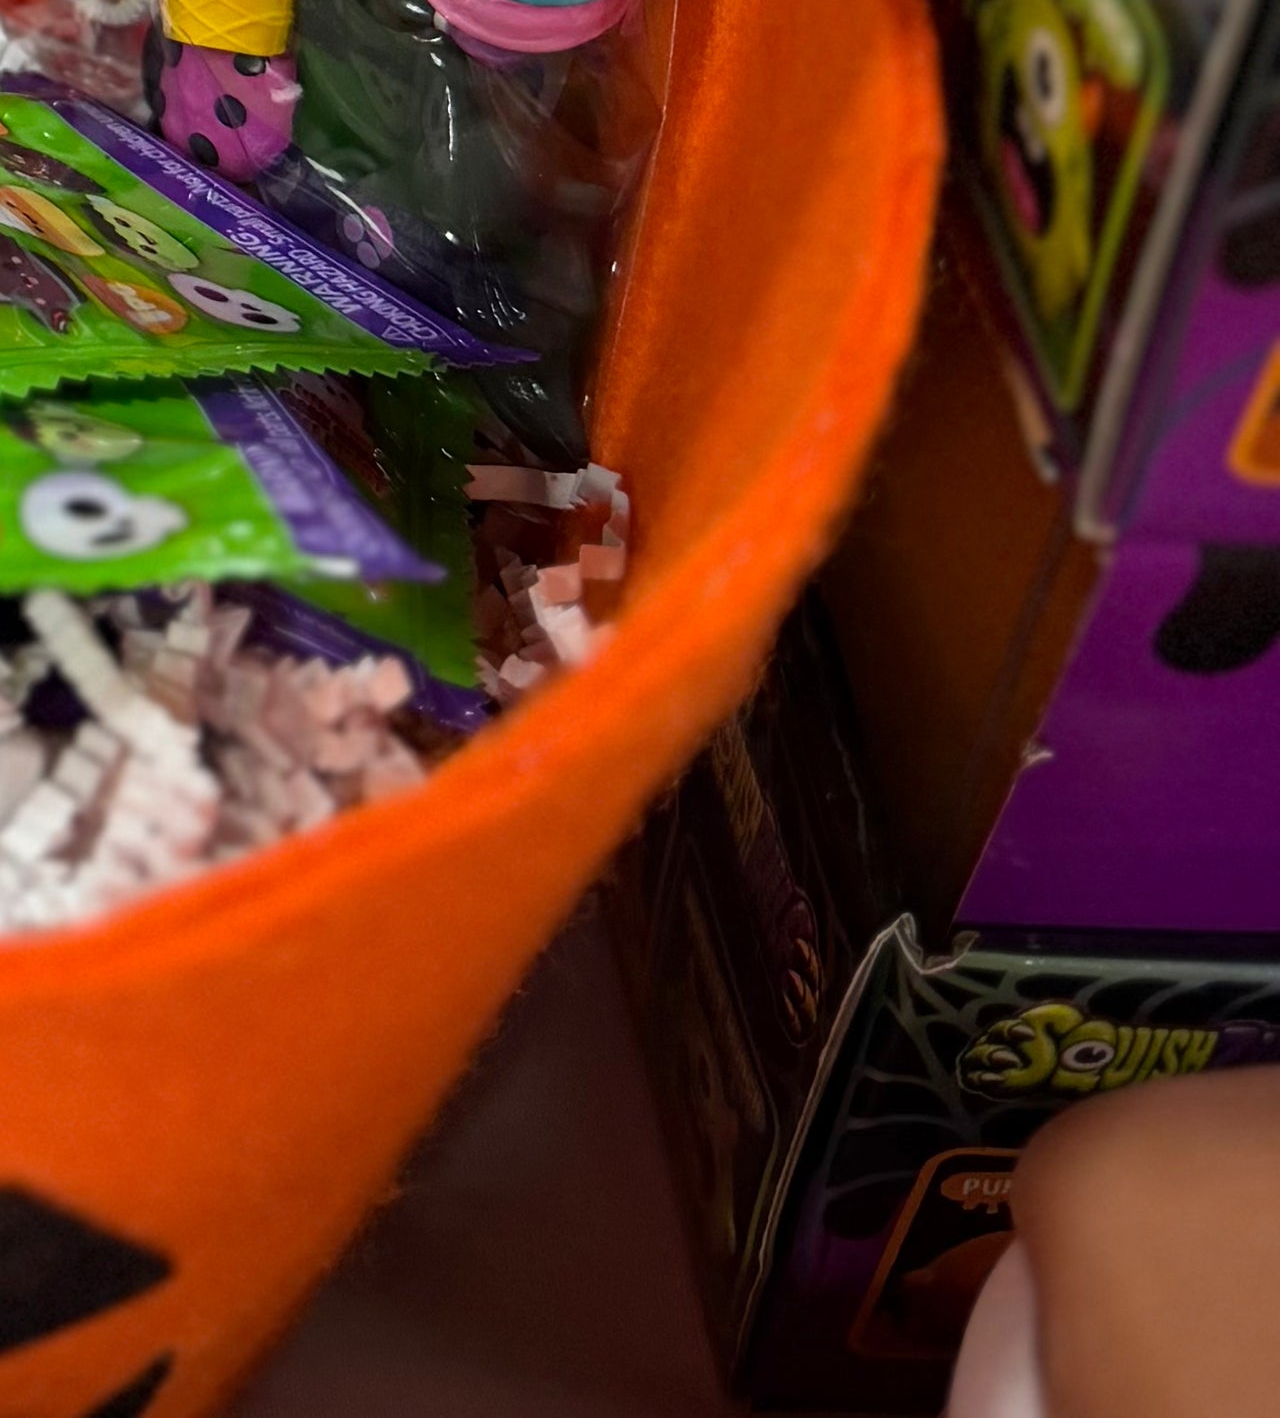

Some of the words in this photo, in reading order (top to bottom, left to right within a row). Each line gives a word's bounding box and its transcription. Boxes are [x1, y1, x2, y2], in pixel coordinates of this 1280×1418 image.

[236, 215, 292, 246] Small
[225, 226, 363, 314] WARNING:
[287, 248, 365, 295] HAZARD
[352, 290, 439, 341] CHOKING
